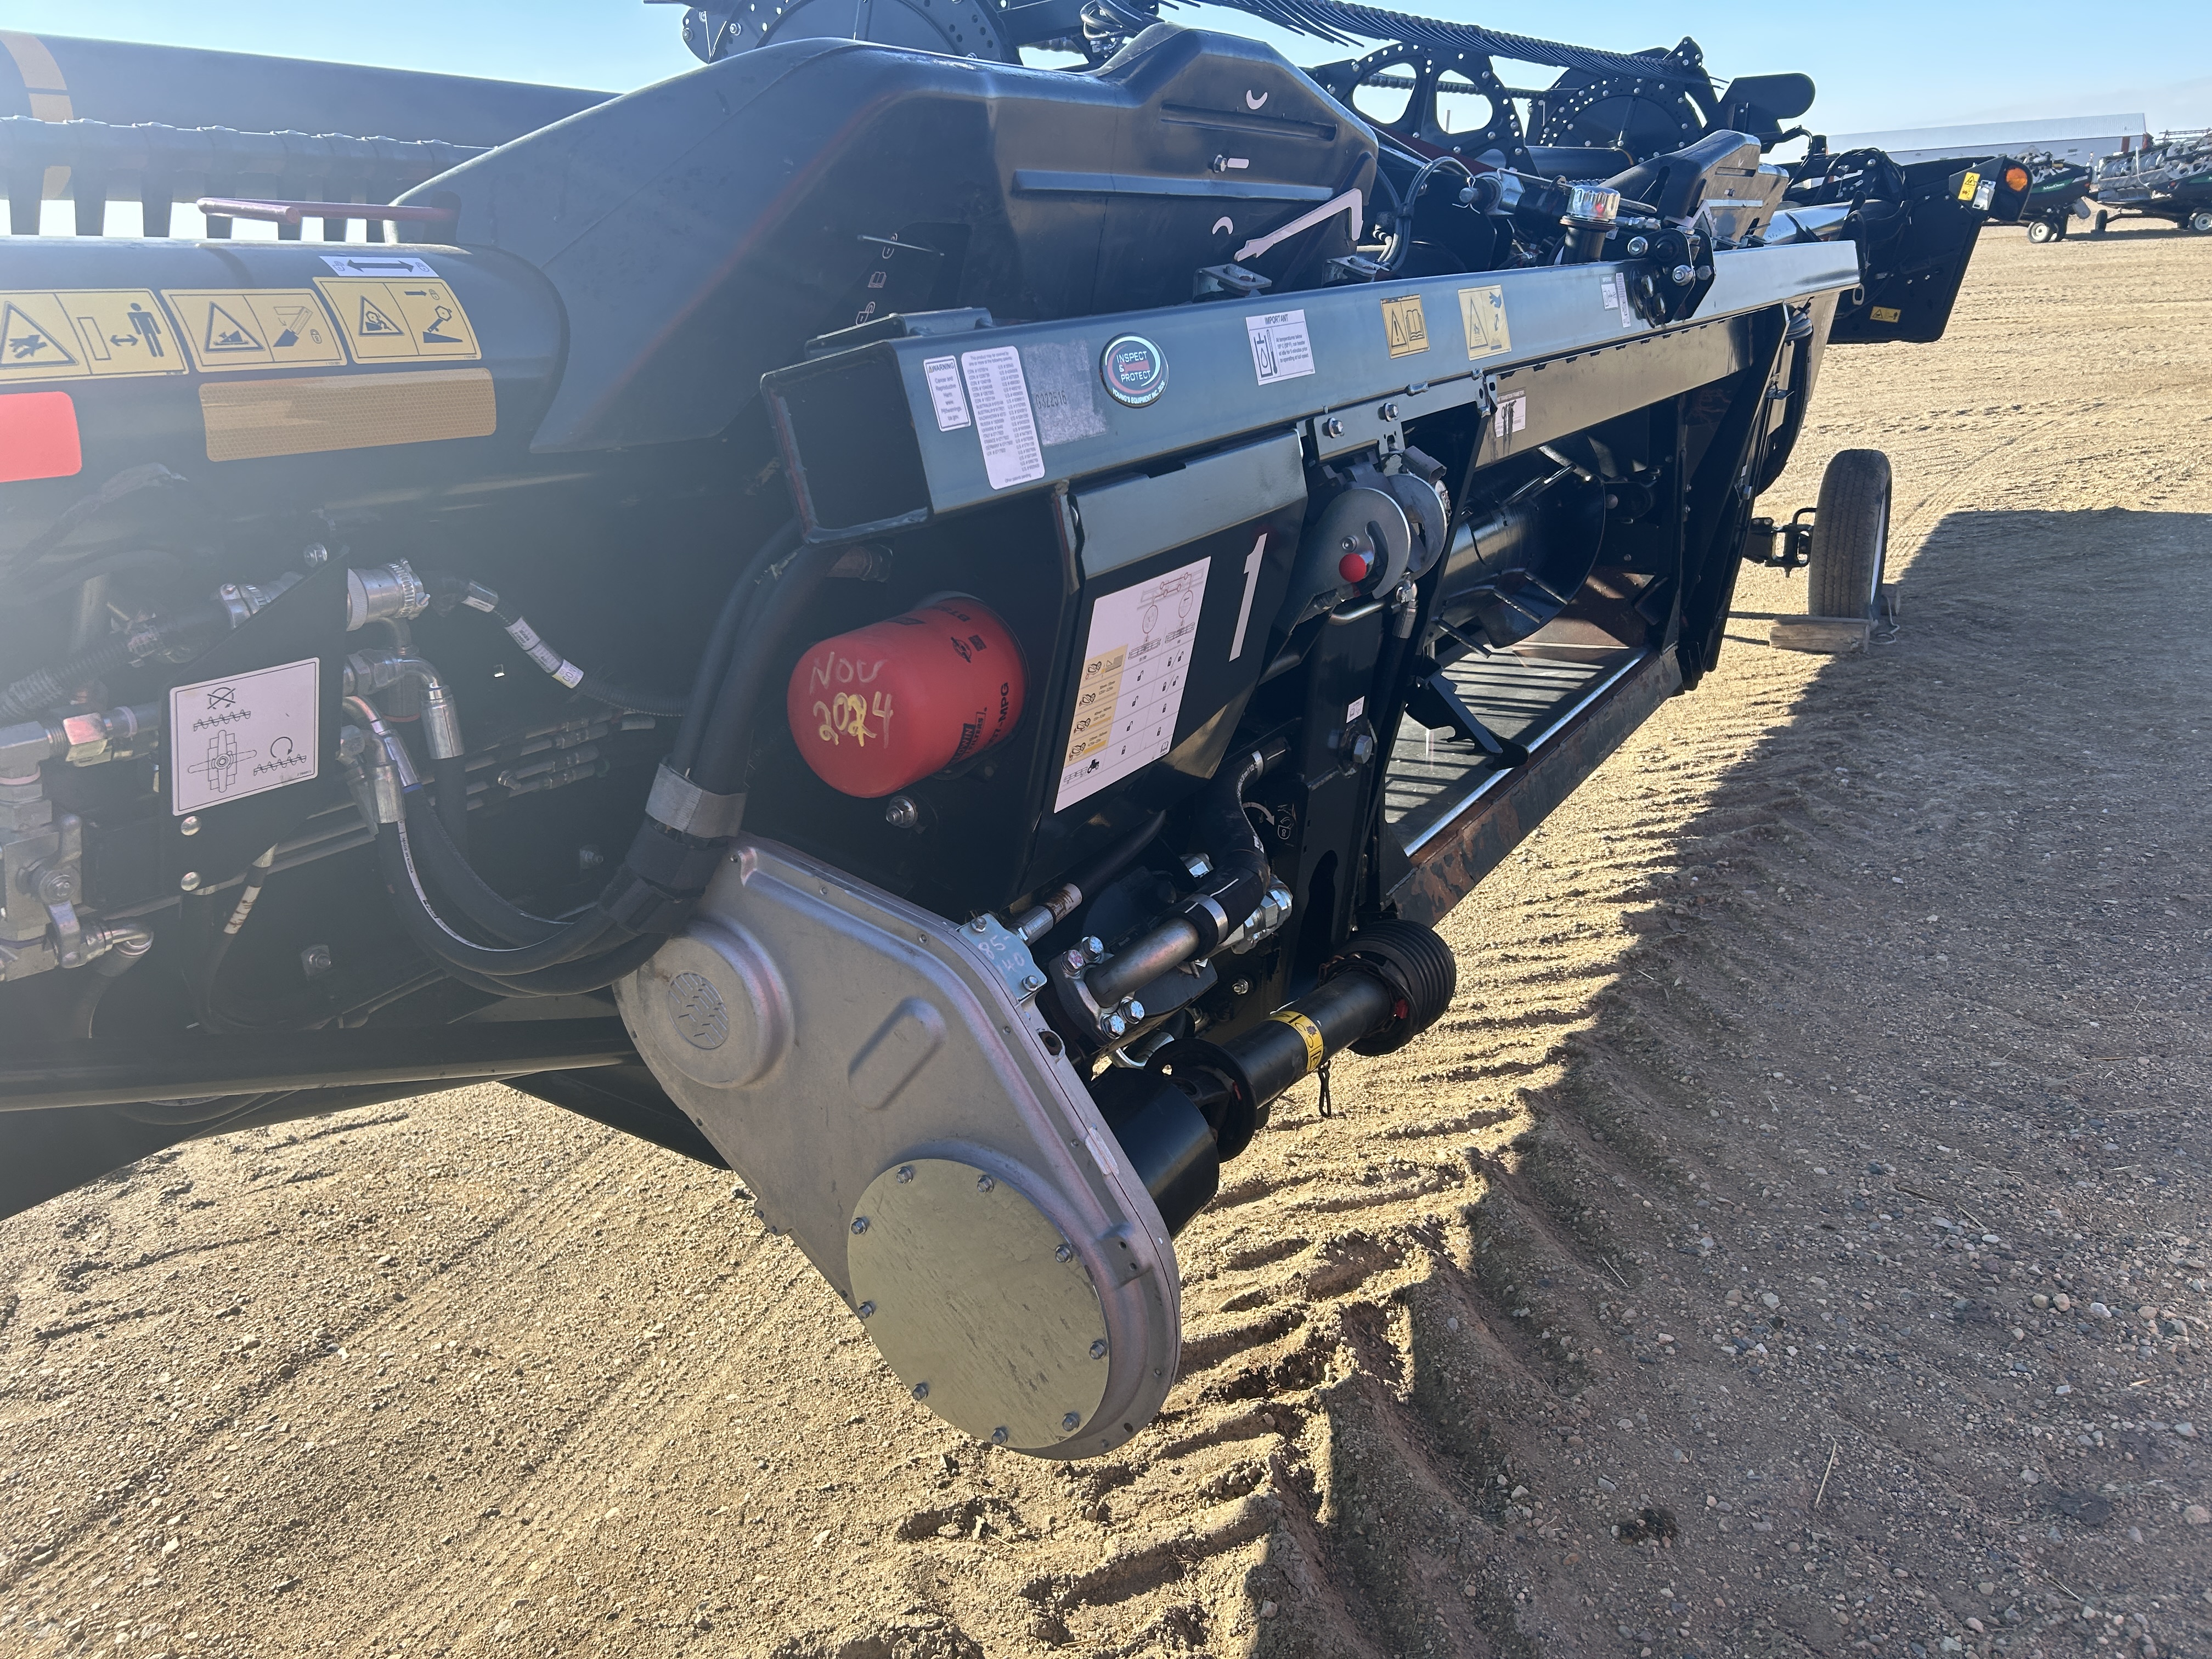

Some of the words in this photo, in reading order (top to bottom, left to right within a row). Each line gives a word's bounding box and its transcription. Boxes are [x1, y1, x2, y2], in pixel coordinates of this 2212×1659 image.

[1265, 314, 1288, 324] IMPORTANT
[1116, 351, 1147, 363] INSPECT
[932, 362, 954, 372] WARNING
[1119, 364, 1125, 373] &
[1121, 370, 1150, 382] PROTECT
[1035, 390, 1067, 410] G322516
[1112, 387, 1130, 403] YOUNG'S
[1131, 394, 1152, 404] EQUIPMENT
[1228, 533, 1268, 662] 1
